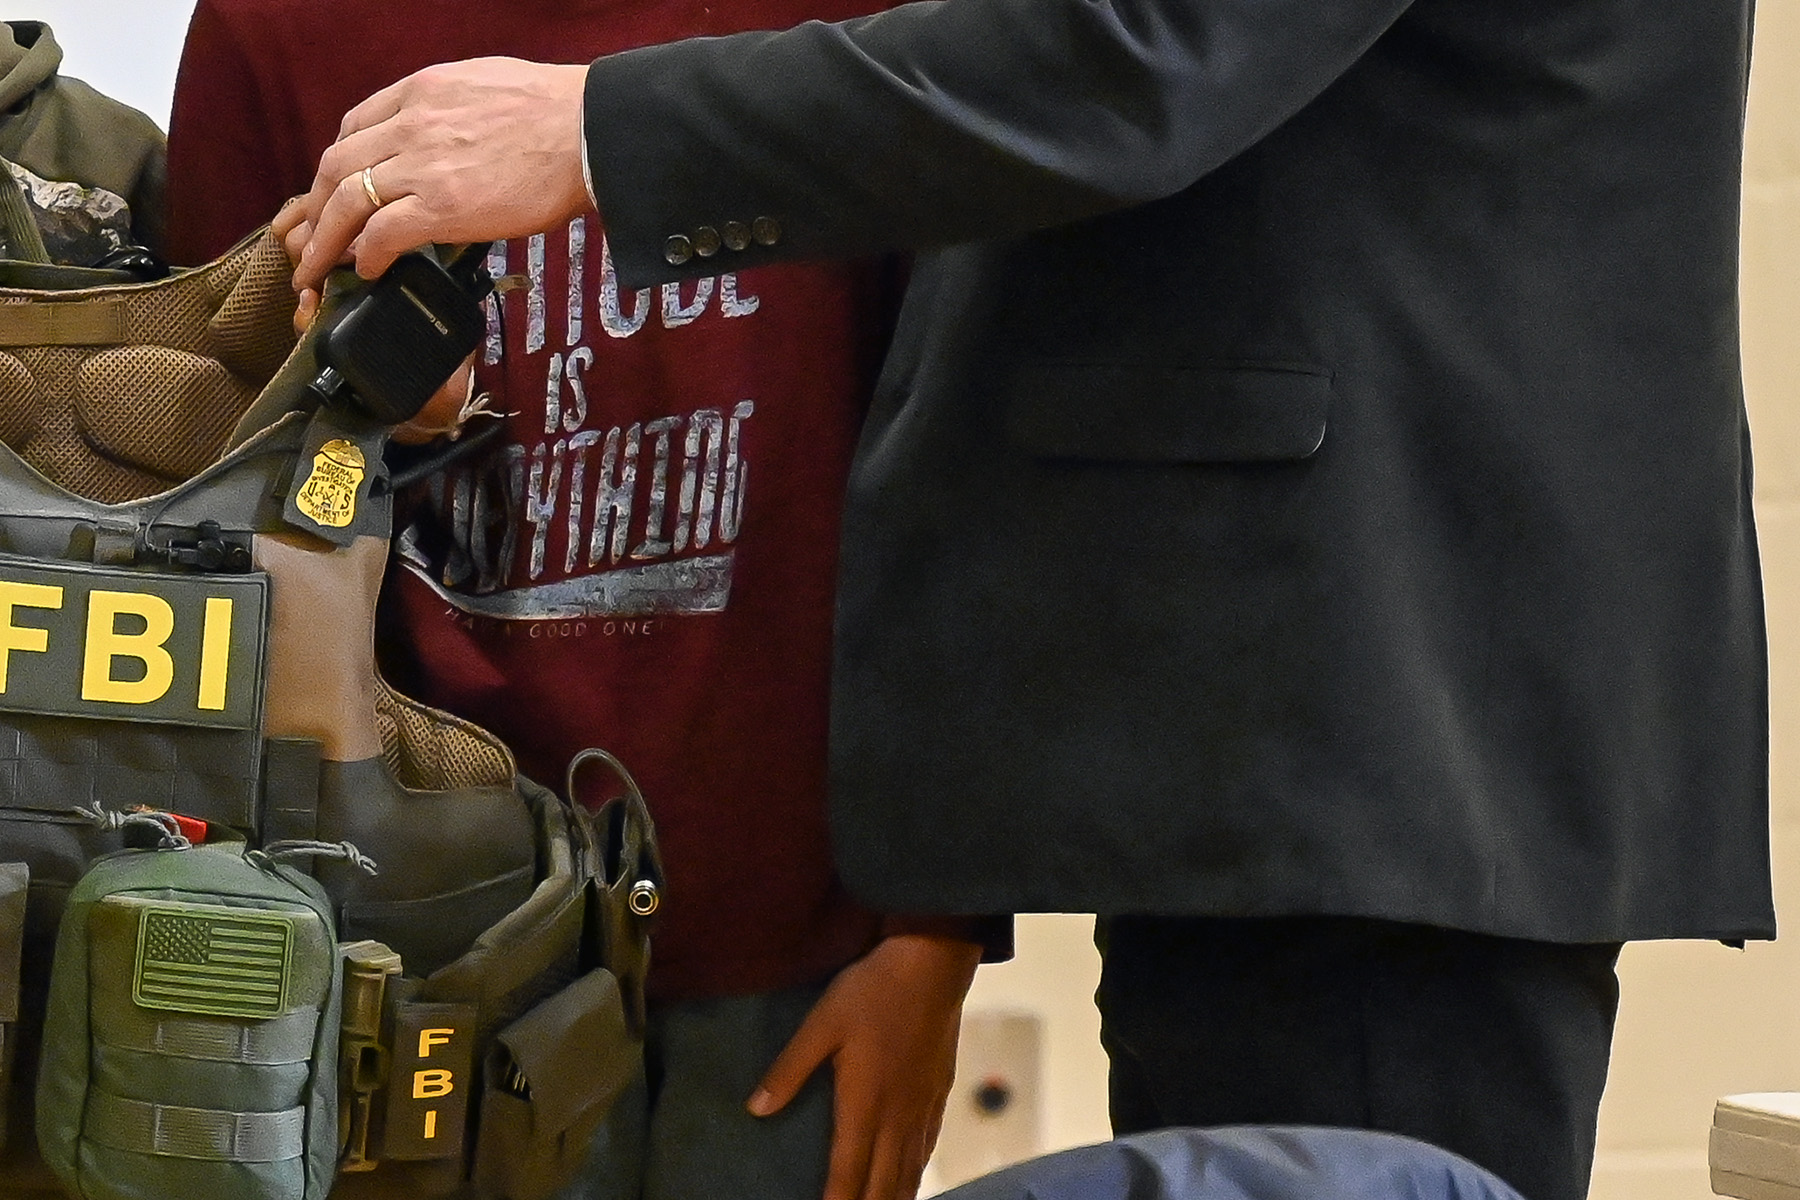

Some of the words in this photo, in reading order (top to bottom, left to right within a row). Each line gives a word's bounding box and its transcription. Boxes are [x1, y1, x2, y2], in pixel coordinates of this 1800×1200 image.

[544, 346, 594, 435] IS
[529, 621, 588, 639] GOOD
[412, 1028, 455, 1139] FBI
